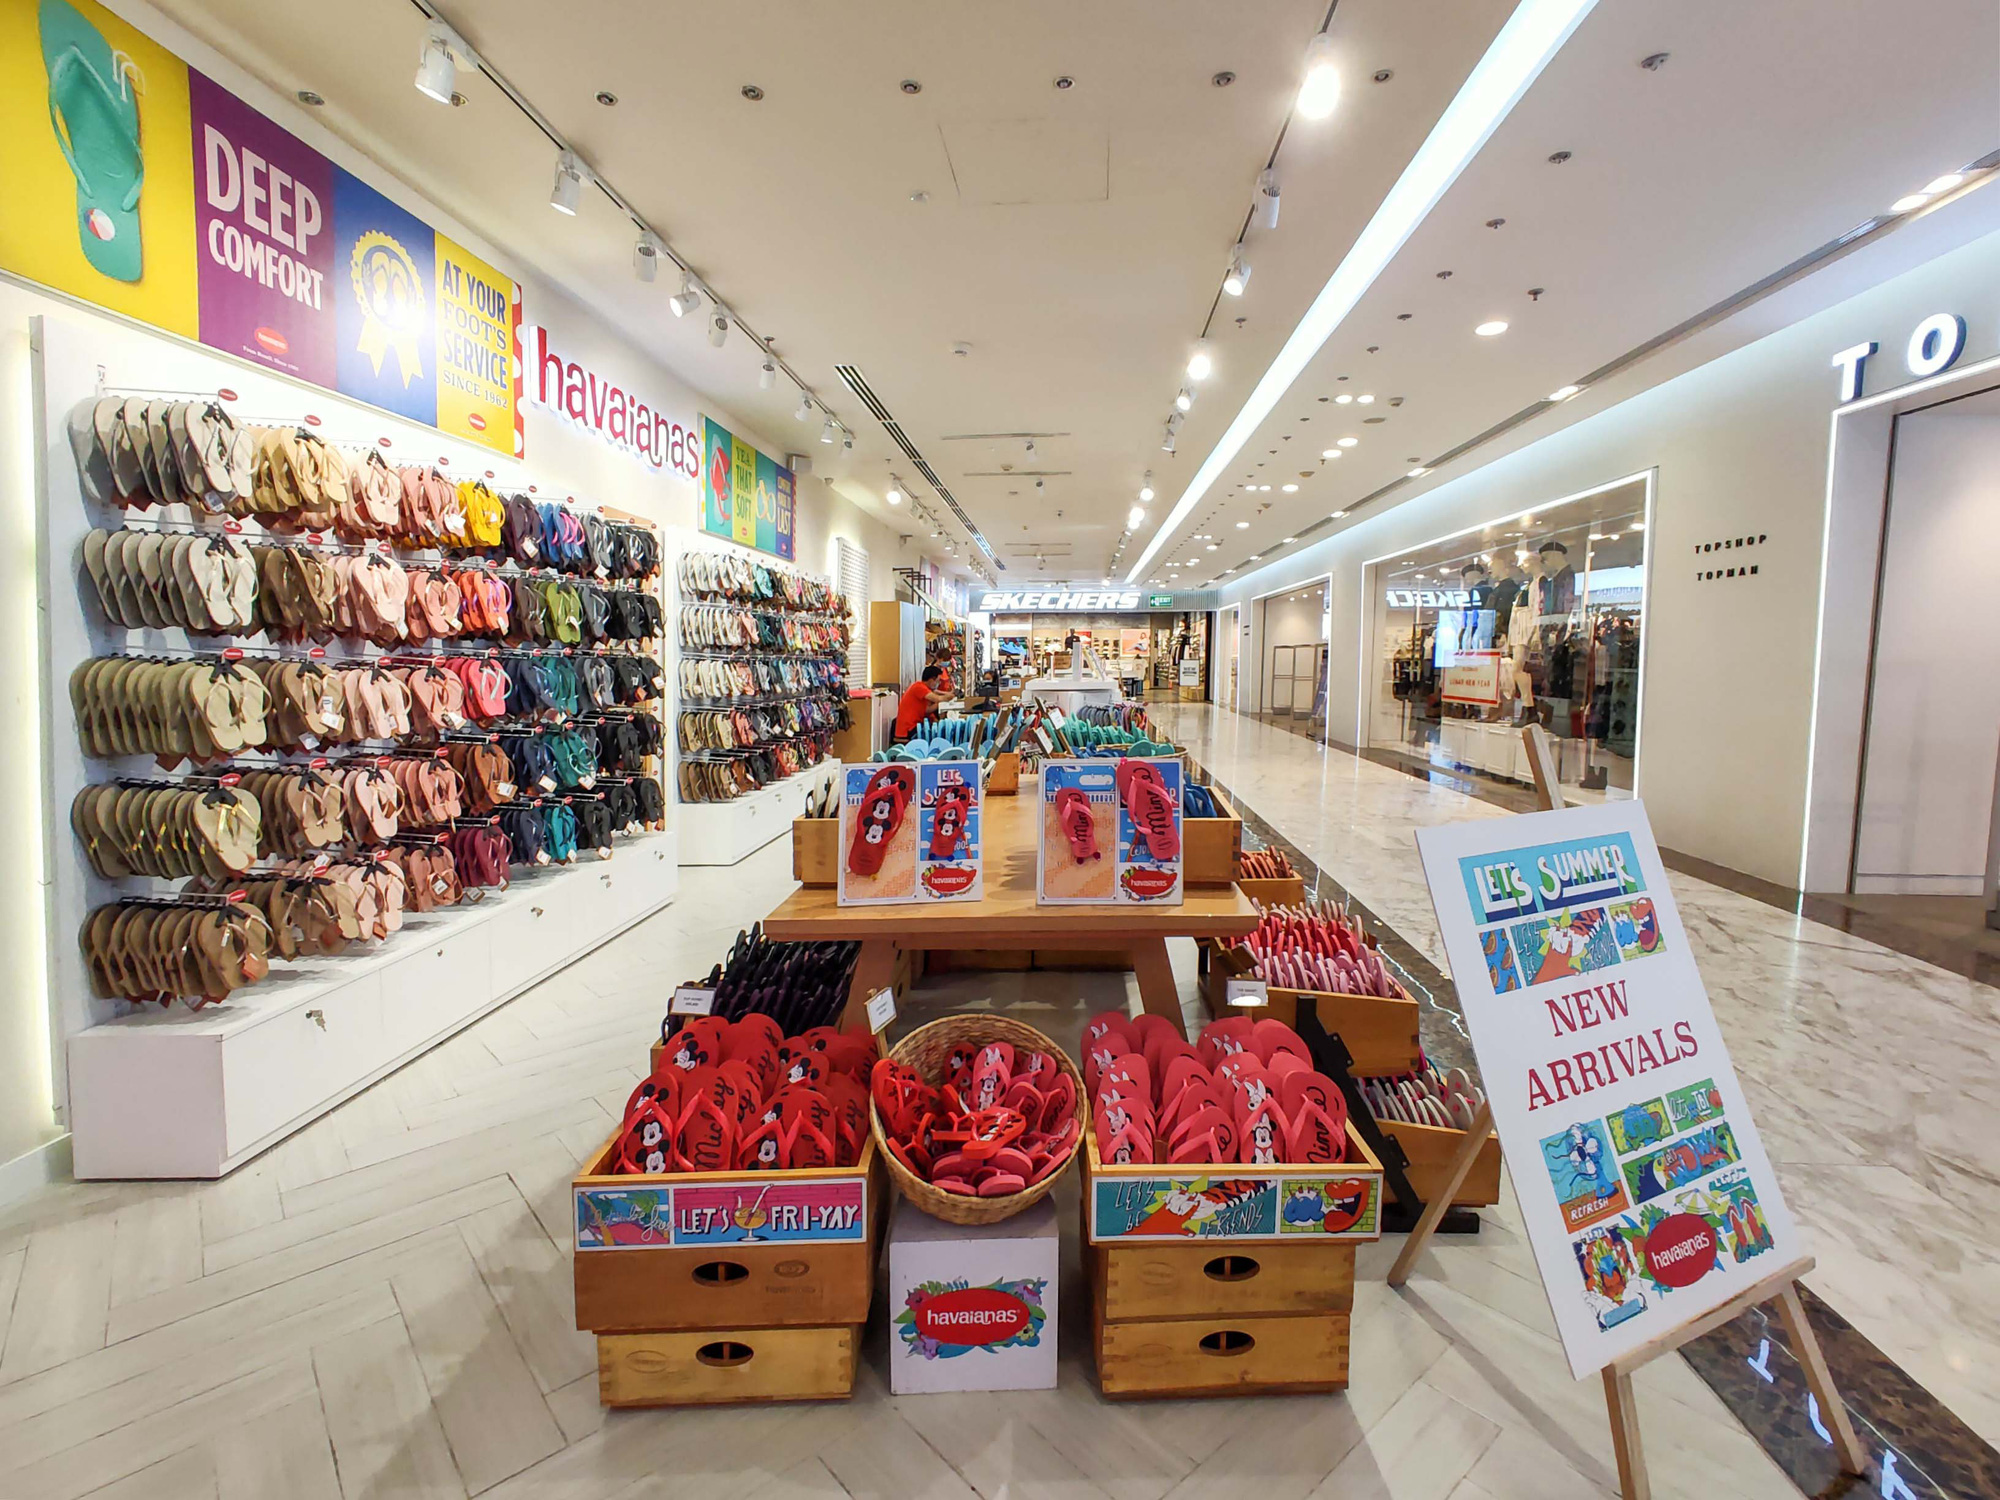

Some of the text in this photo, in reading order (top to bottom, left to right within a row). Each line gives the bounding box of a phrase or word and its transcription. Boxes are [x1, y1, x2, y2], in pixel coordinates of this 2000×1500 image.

[204, 123, 322, 256] DEEP
[208, 218, 323, 311] COMFORT
[443, 259, 506, 325] AT YOUR
[443, 298, 506, 350] FOOT'S
[444, 328, 507, 389] SERVICE
[443, 369, 508, 409] SINCE 1962
[535, 325, 699, 478] havaianas
[736, 464, 752, 494] THAT
[736, 493, 752, 522] SOFT
[777, 506, 791, 536] LAST
[1694, 534, 1767, 554] TOPSHOP
[1696, 565, 1759, 581] TOPMAN
[979, 591, 1141, 610] SKECHERS
[937, 769, 964, 786] LET'S
[1473, 844, 1637, 914] LET'S SUMMER
[1544, 979, 1629, 1038] NEW
[1528, 1020, 1698, 1112] ARRIVALS
[681, 1204, 859, 1235] LET'S FRI-YAY
[1570, 1197, 1609, 1221] REFRESH
[1651, 1231, 1710, 1270] havaianas
[927, 1309, 1018, 1326] havaianas
